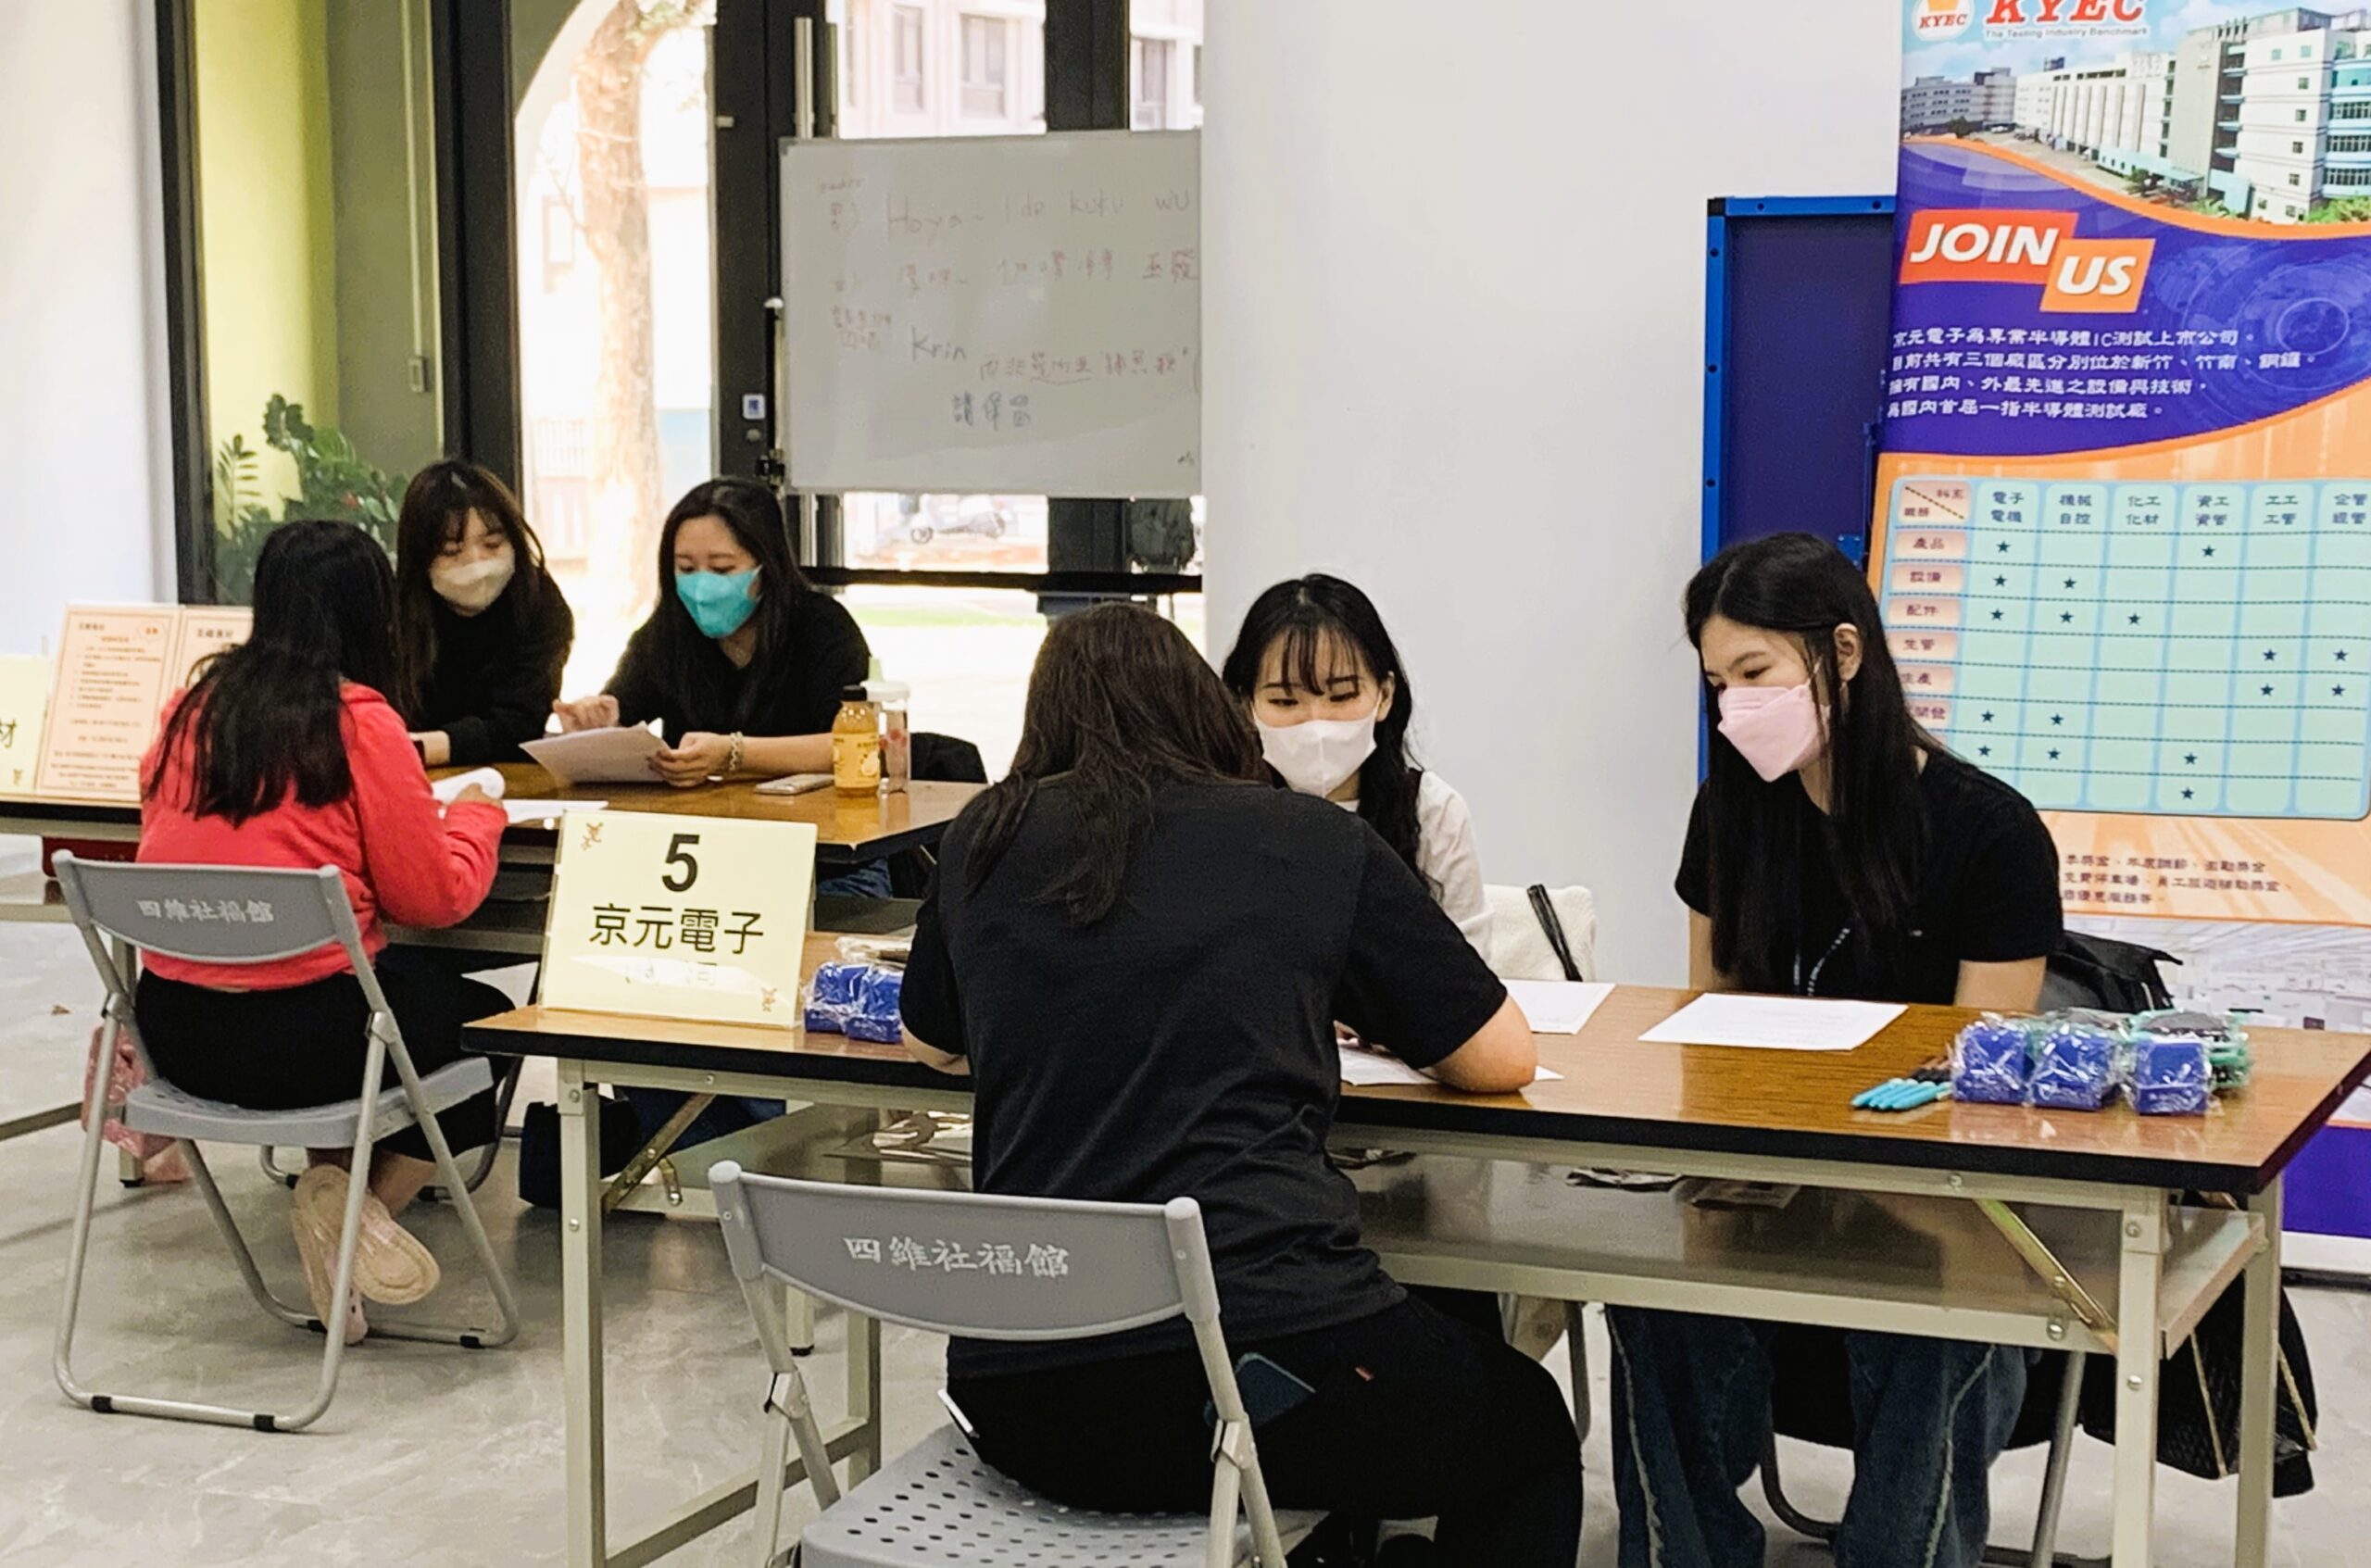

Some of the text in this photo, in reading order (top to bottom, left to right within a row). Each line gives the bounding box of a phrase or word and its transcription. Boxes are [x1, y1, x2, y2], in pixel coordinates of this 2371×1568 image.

[1986, 0, 2143, 24] KYEC
[1919, 13, 1968, 30] KYEC
[1986, 26, 2147, 38] The Testing Industry Benchmark
[1910, 222, 2059, 264] JOIN
[2056, 256, 2137, 295] US
[1992, 491, 2025, 505] 電子
[2059, 494, 2092, 507] 機械
[2127, 495, 2161, 508] 化工
[2197, 495, 2229, 508] 資工
[2264, 495, 2298, 506] 工工
[2333, 493, 2367, 506] 企管
[1990, 509, 2023, 523] 電機
[2059, 512, 2091, 525] 自控
[2126, 513, 2159, 526] 化材
[2196, 513, 2227, 526] 資管
[2264, 512, 2297, 525] 工管
[1913, 537, 1945, 550] 產品
[1910, 571, 1942, 583] 設備
[1906, 604, 1938, 617] 配件
[1903, 638, 1936, 651] 生管
[1901, 671, 1932, 685] 生產
[660, 833, 700, 893] 5
[136, 898, 275, 924] 四維社福館
[587, 901, 765, 955] 京元電子
[843, 1235, 1071, 1279] 四維社福館
